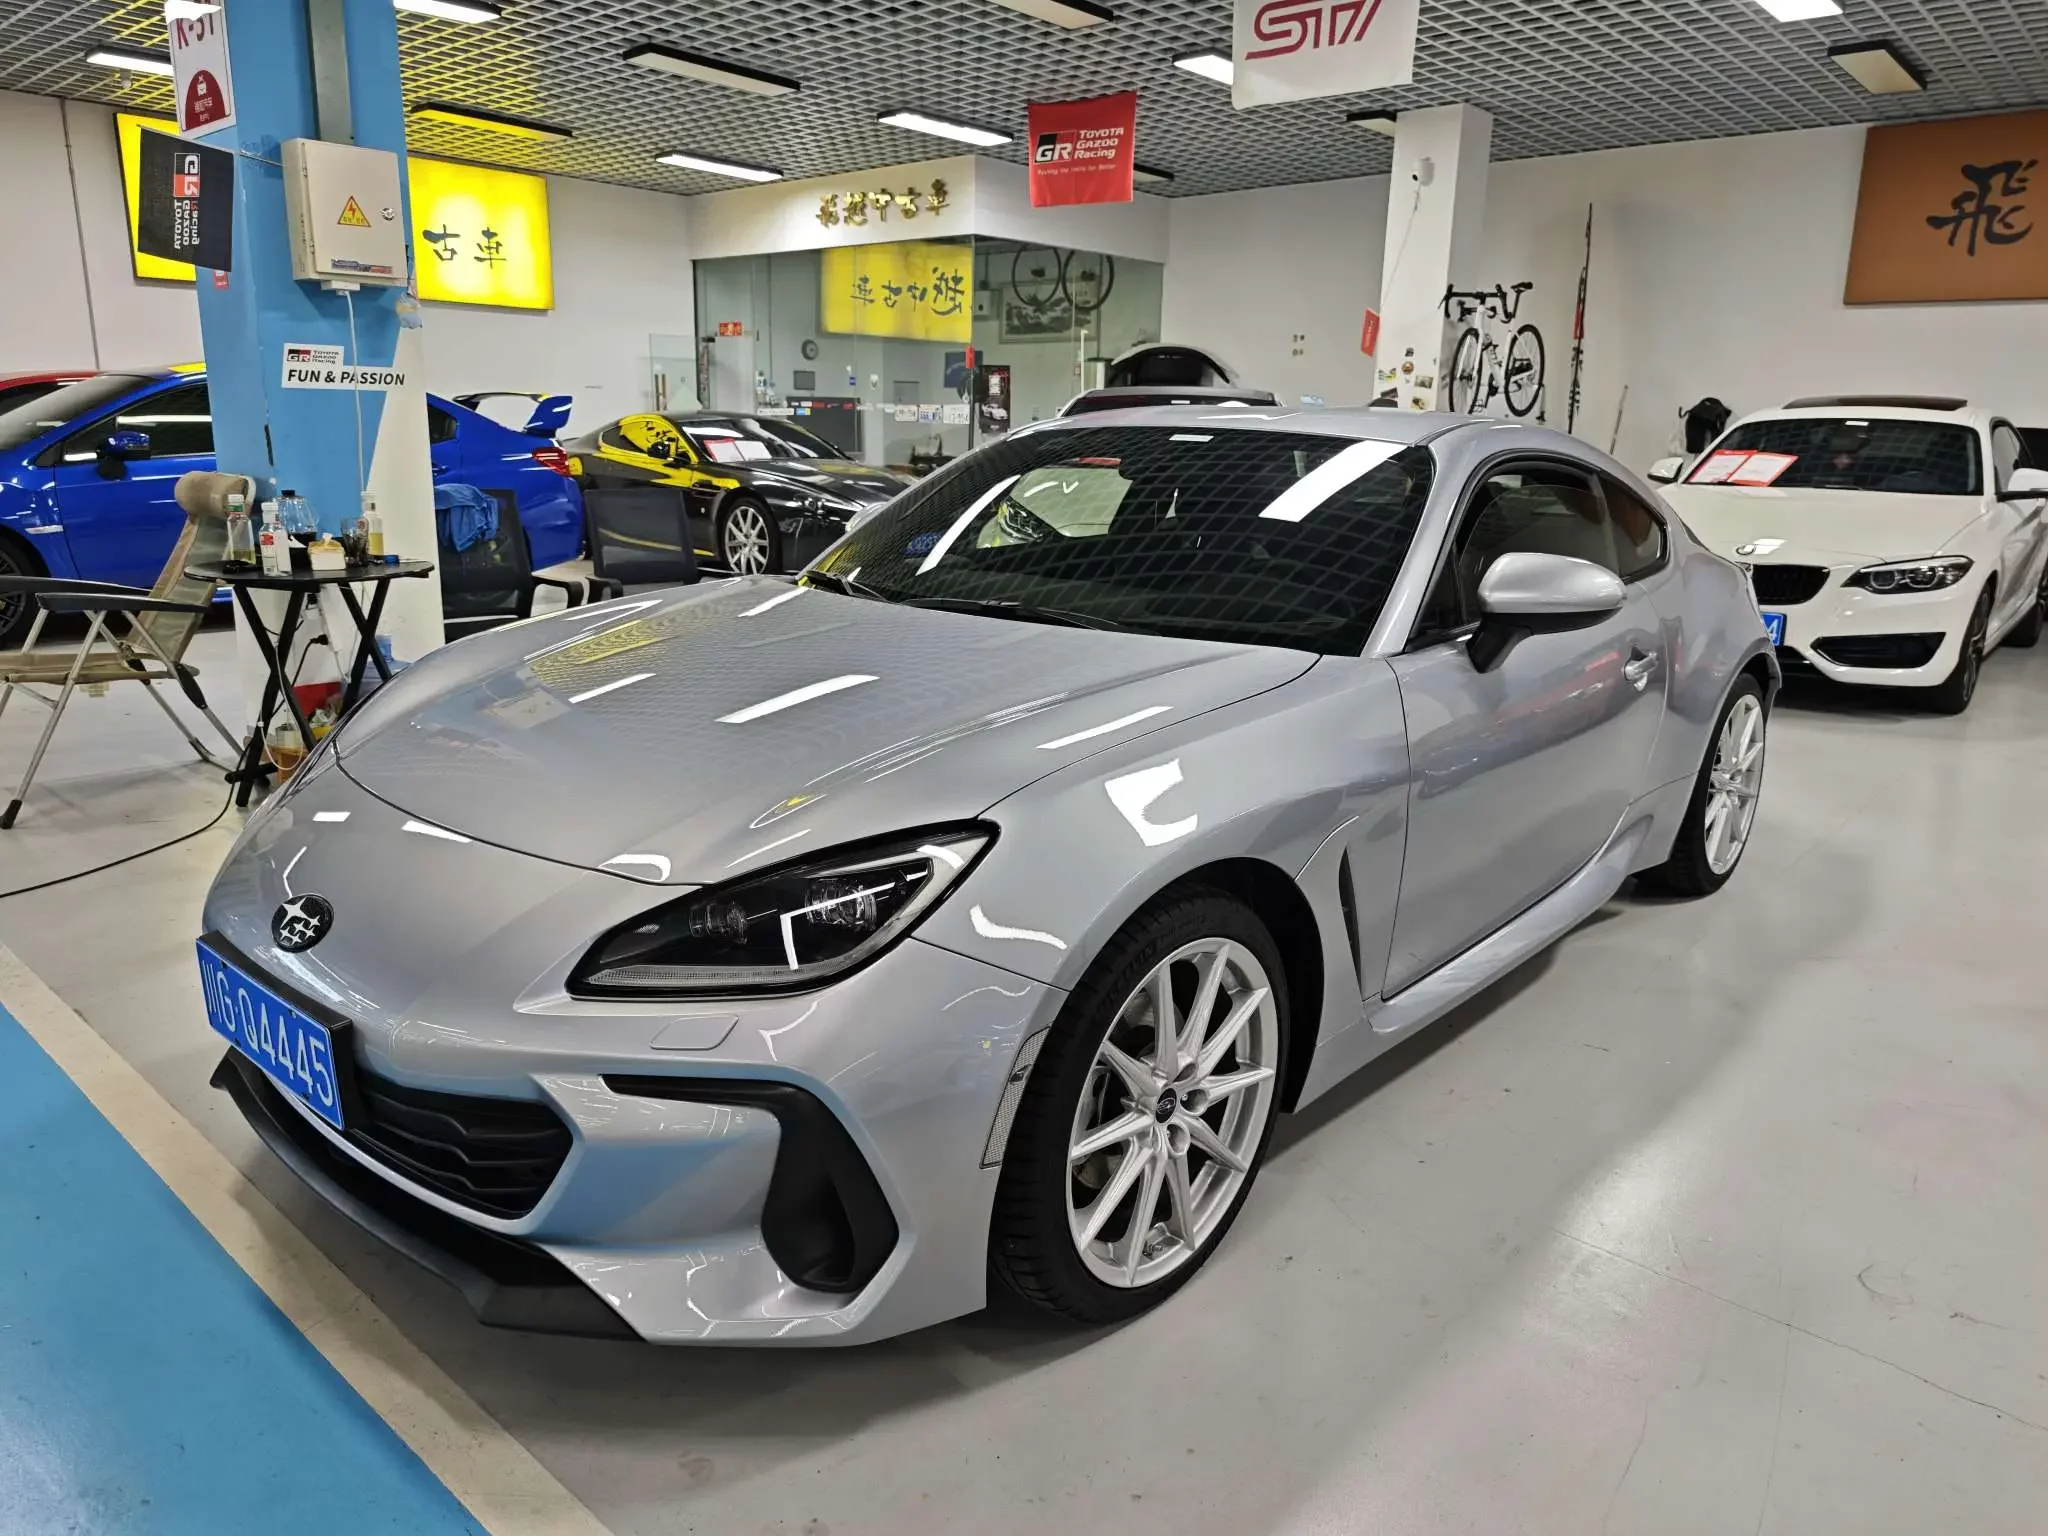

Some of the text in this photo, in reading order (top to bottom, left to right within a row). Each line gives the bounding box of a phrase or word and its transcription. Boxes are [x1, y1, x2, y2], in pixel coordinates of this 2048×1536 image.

[1079, 127, 1124, 139] TOYOTA
[1035, 142, 1073, 162] GR
[1076, 138, 1118, 149] GAZOO
[1074, 148, 1116, 160] Racing
[1926, 158, 2039, 257] 飛
[422, 224, 507, 269] 古車
[287, 369, 405, 386] FUN & PASSION
